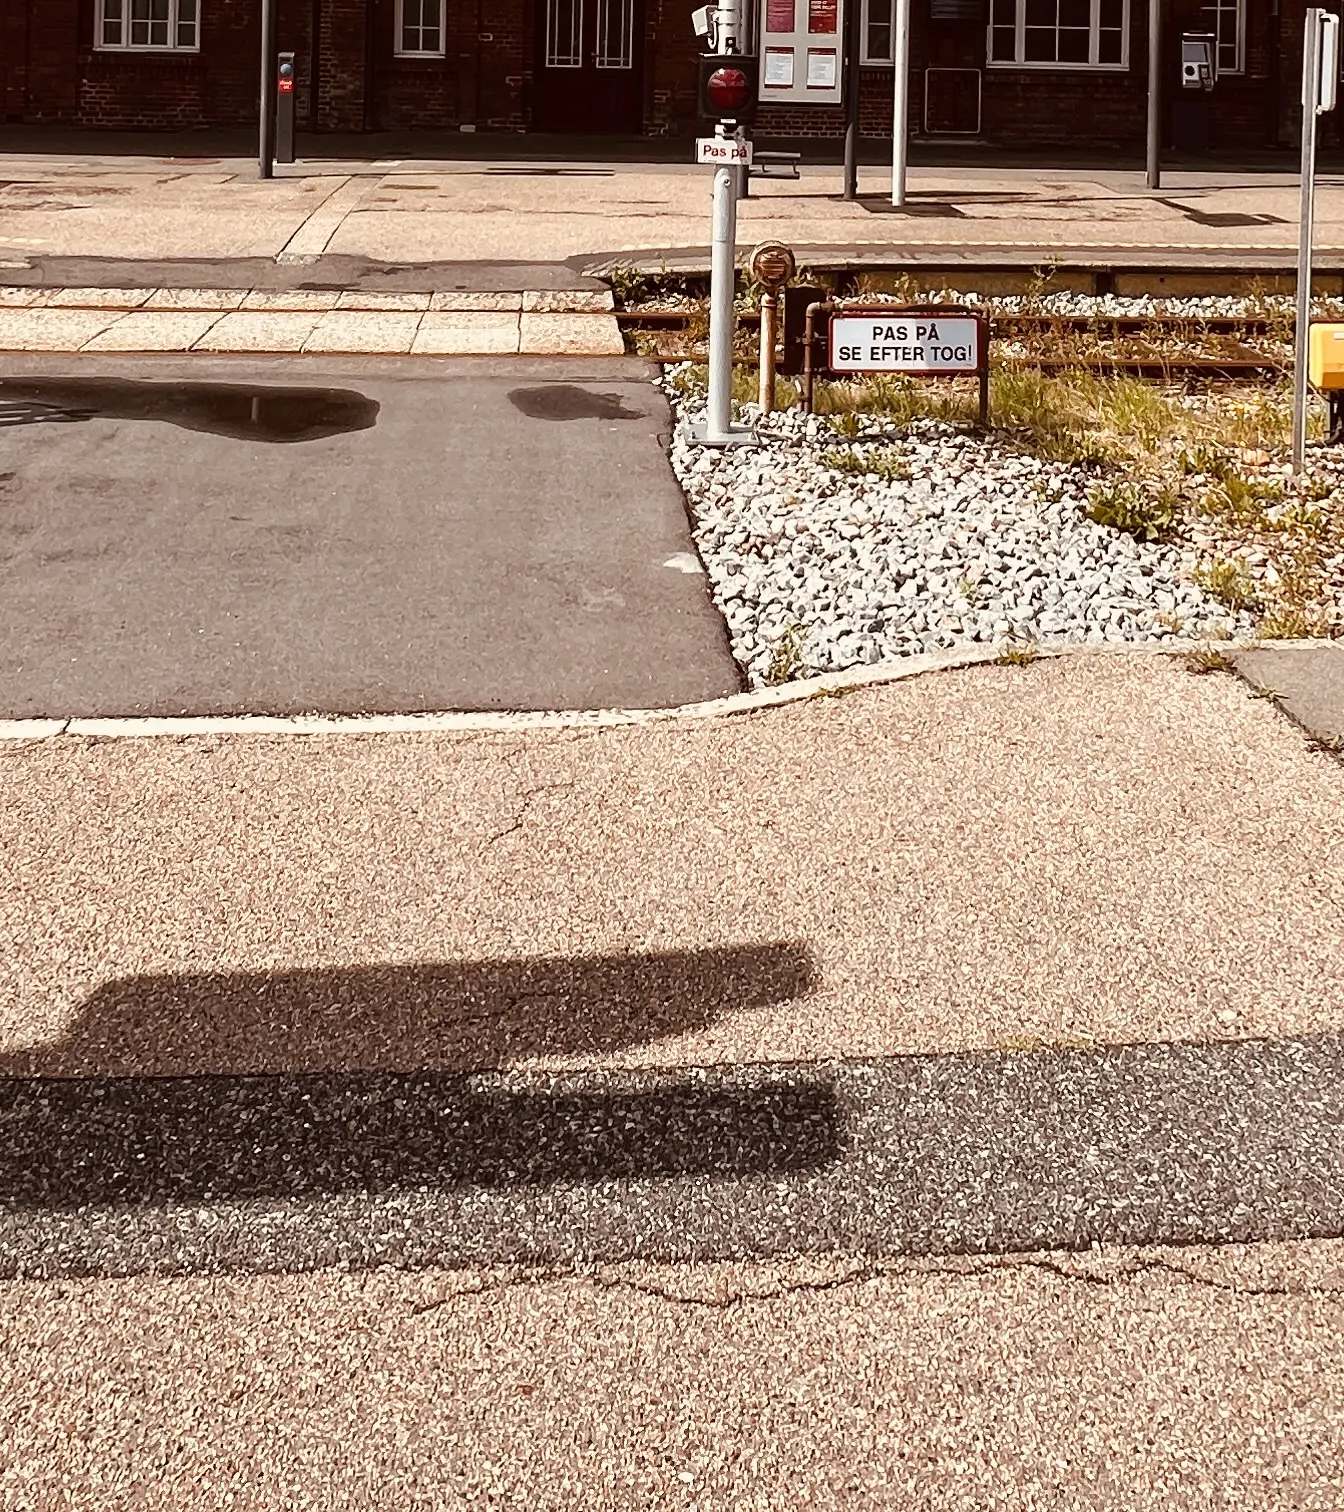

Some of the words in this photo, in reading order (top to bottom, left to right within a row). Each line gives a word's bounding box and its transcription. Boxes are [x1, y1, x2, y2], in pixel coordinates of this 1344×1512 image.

[703, 145, 726, 157] Pas
[731, 146, 747, 159] på
[872, 326, 908, 341] PAS
[916, 323, 940, 341] PÅ
[839, 346, 862, 361] SE
[870, 346, 924, 361] EFTER
[930, 344, 973, 362] TOG!
